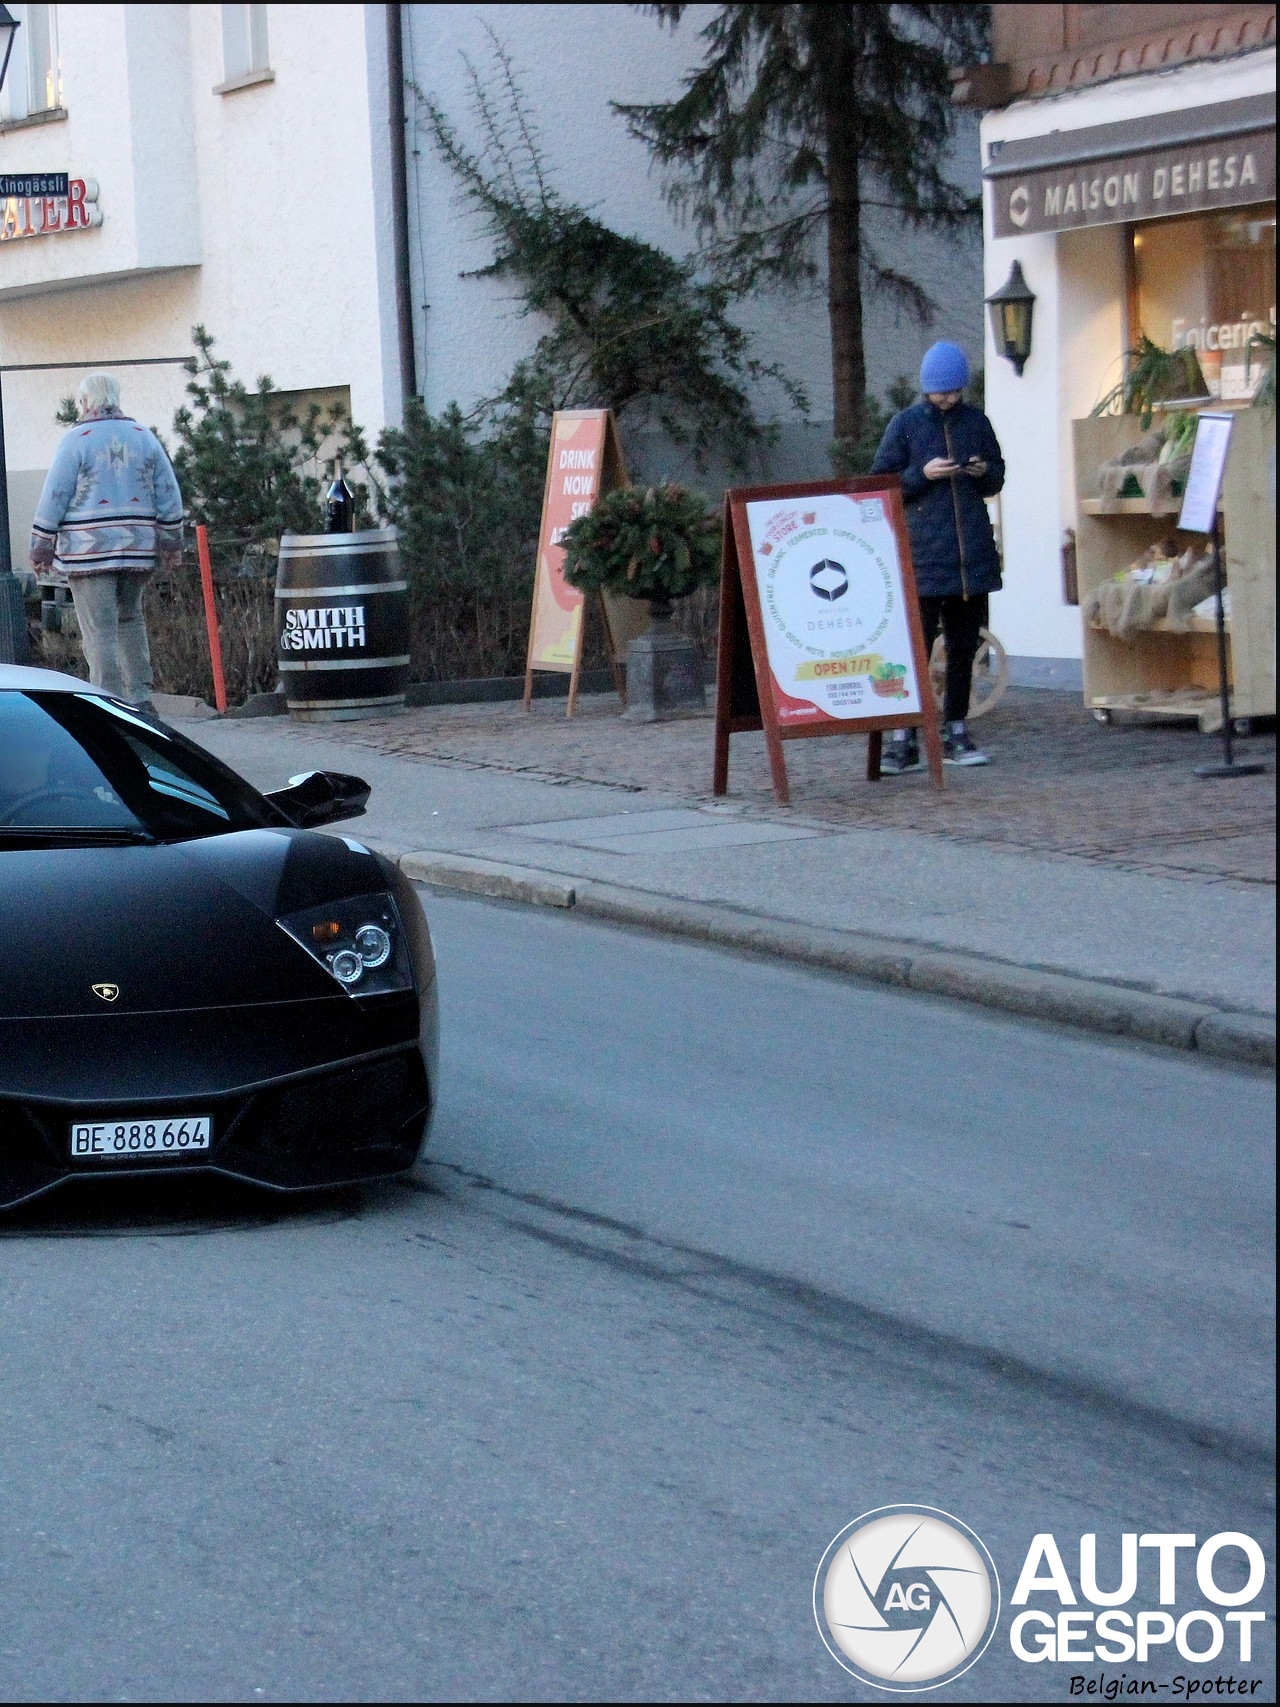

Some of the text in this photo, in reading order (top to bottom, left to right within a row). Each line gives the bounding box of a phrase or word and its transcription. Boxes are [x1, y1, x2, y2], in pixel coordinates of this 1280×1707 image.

[1044, 152, 1256, 217] MAISON DEHESA
[559, 449, 596, 469] DRINK
[563, 476, 593, 495] NOW
[773, 520, 799, 542] STORE
[767, 548, 787, 579] ORGANIC
[787, 527, 828, 548] FERMENTED
[832, 528, 857, 542] SUPER
[856, 538, 874, 555] FOOD
[875, 556, 893, 589] NATURAL
[285, 606, 365, 630] SMITH
[807, 617, 863, 631] DEHESA
[786, 632, 803, 650] FOOD
[866, 617, 889, 645] HOLISTIC
[805, 645, 825, 658] SLOW
[813, 658, 871, 676] OPEN 7/7
